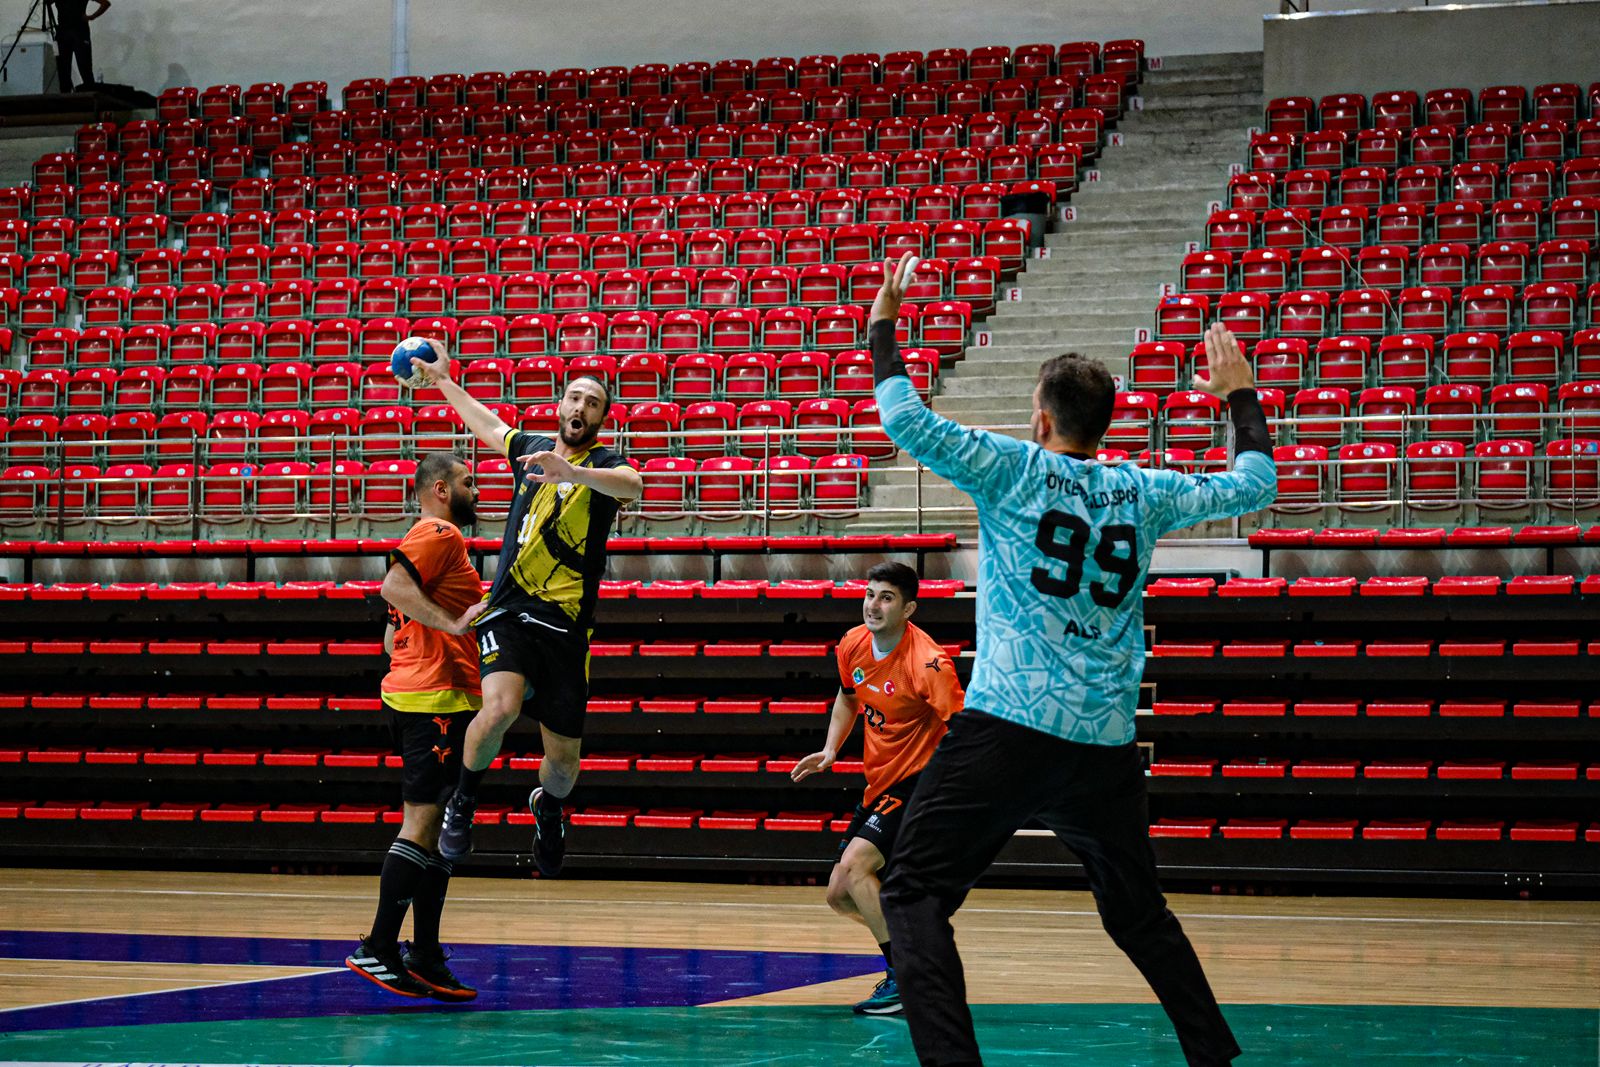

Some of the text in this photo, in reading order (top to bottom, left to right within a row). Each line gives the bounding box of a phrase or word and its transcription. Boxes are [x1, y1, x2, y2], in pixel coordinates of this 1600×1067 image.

[1150, 58, 1161, 69] M
[1133, 101, 1140, 110] L
[1112, 134, 1120, 145] K
[1232, 164, 1240, 175] H
[1089, 172, 1098, 182] H
[1065, 208, 1073, 221] G
[1040, 248, 1047, 259] F
[1011, 289, 1018, 300] E
[979, 333, 988, 346] D
[1139, 329, 1147, 342] D
[517, 513, 537, 545] 11
[1030, 509, 1140, 609] 99
[481, 630, 500, 656] 11
